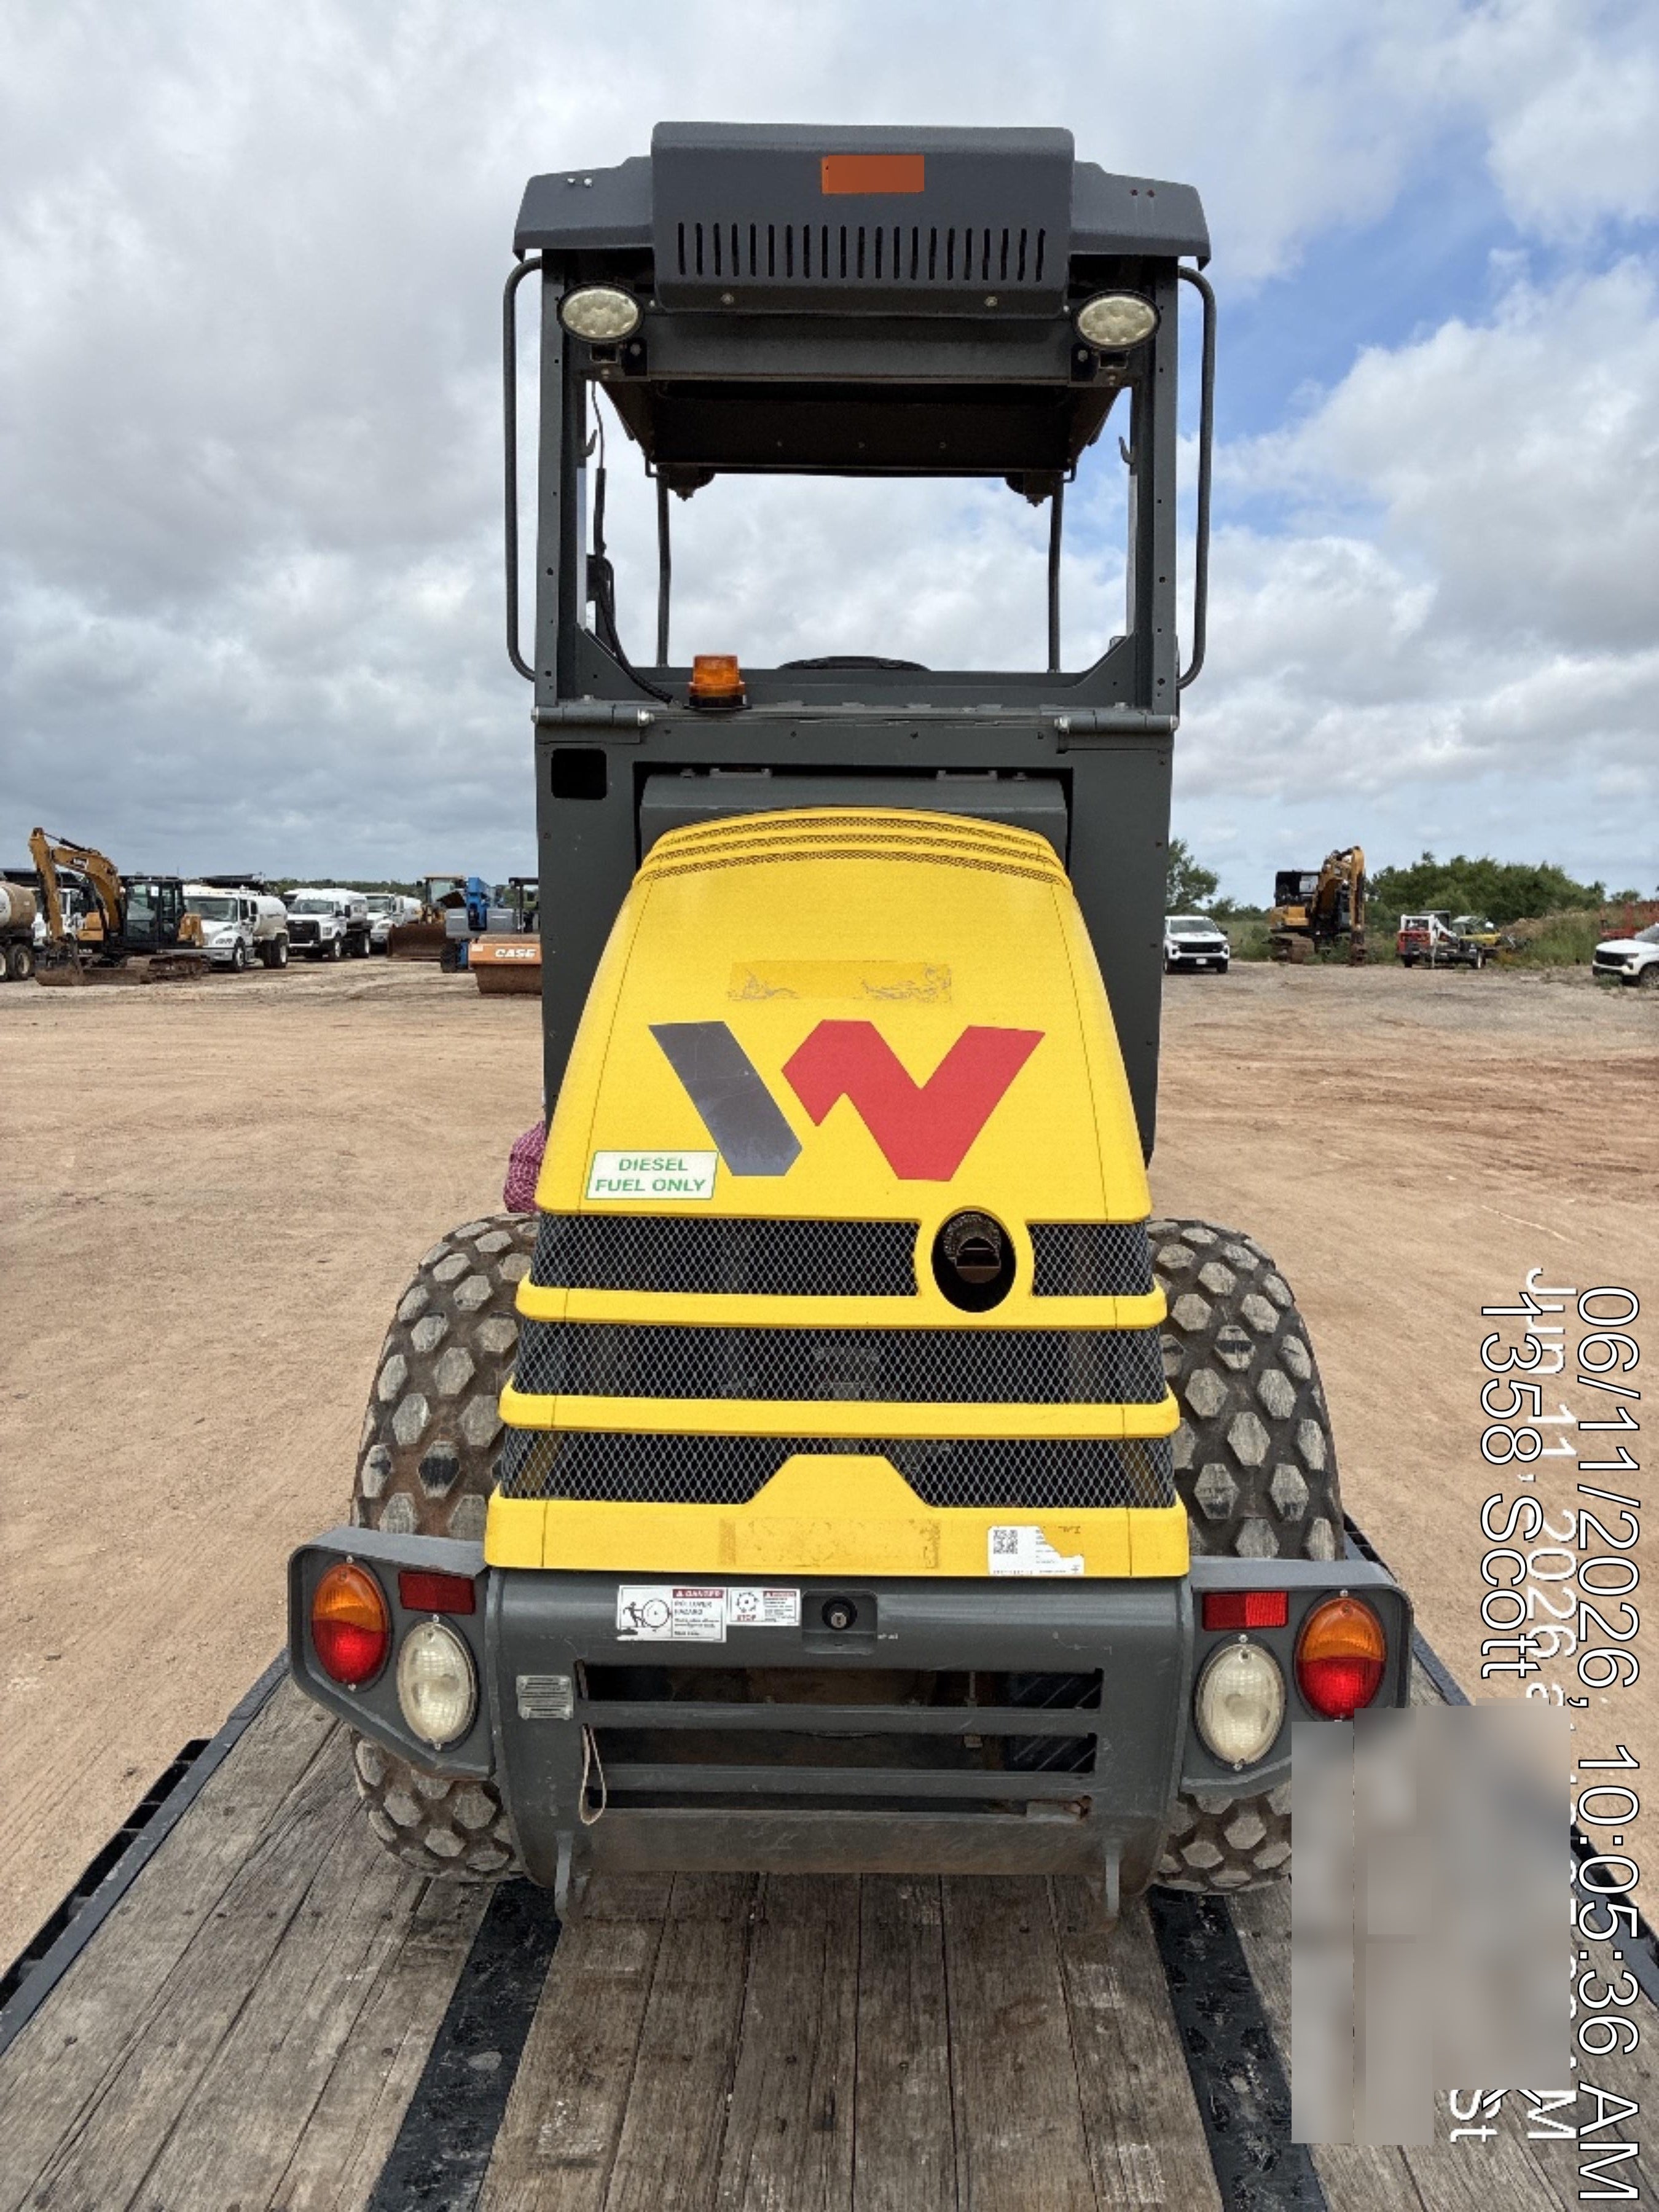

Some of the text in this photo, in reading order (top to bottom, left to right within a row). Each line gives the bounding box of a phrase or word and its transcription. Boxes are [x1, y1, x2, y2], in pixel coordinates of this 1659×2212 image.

[495, 948, 536, 958] CASE
[619, 1157, 689, 1171] DIESEL
[595, 1179, 706, 1191] FUEL ONLY
